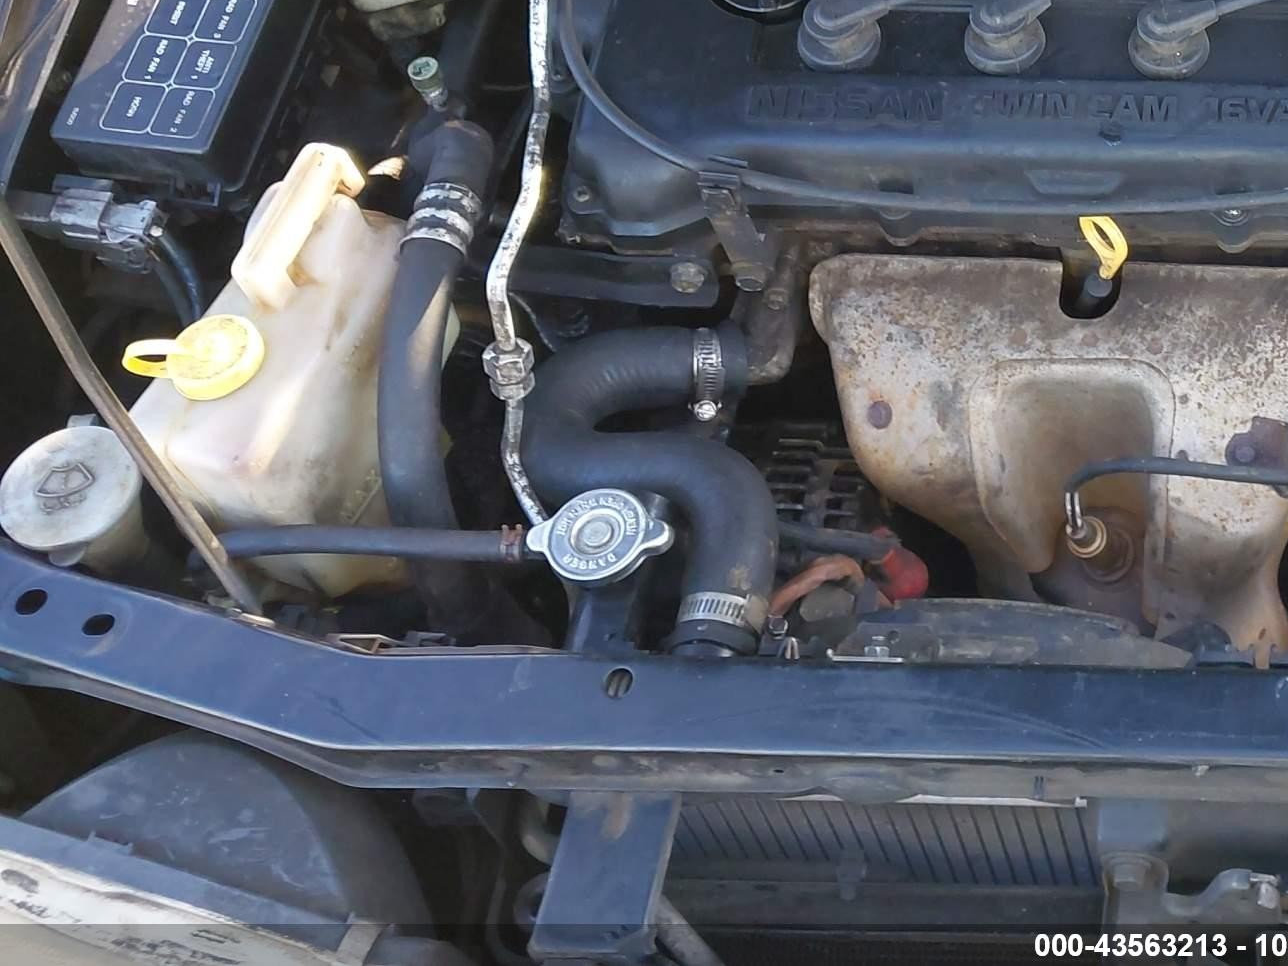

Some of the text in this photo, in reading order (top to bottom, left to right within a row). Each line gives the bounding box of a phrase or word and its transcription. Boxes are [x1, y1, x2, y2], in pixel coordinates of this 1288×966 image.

[217, 15, 229, 30] FAN
[157, 39, 168, 55] RAD
[147, 58, 160, 72] FAN
[183, 90, 195, 106] RAD
[747, 86, 945, 123] NISSAN
[970, 89, 1075, 120] TWIN
